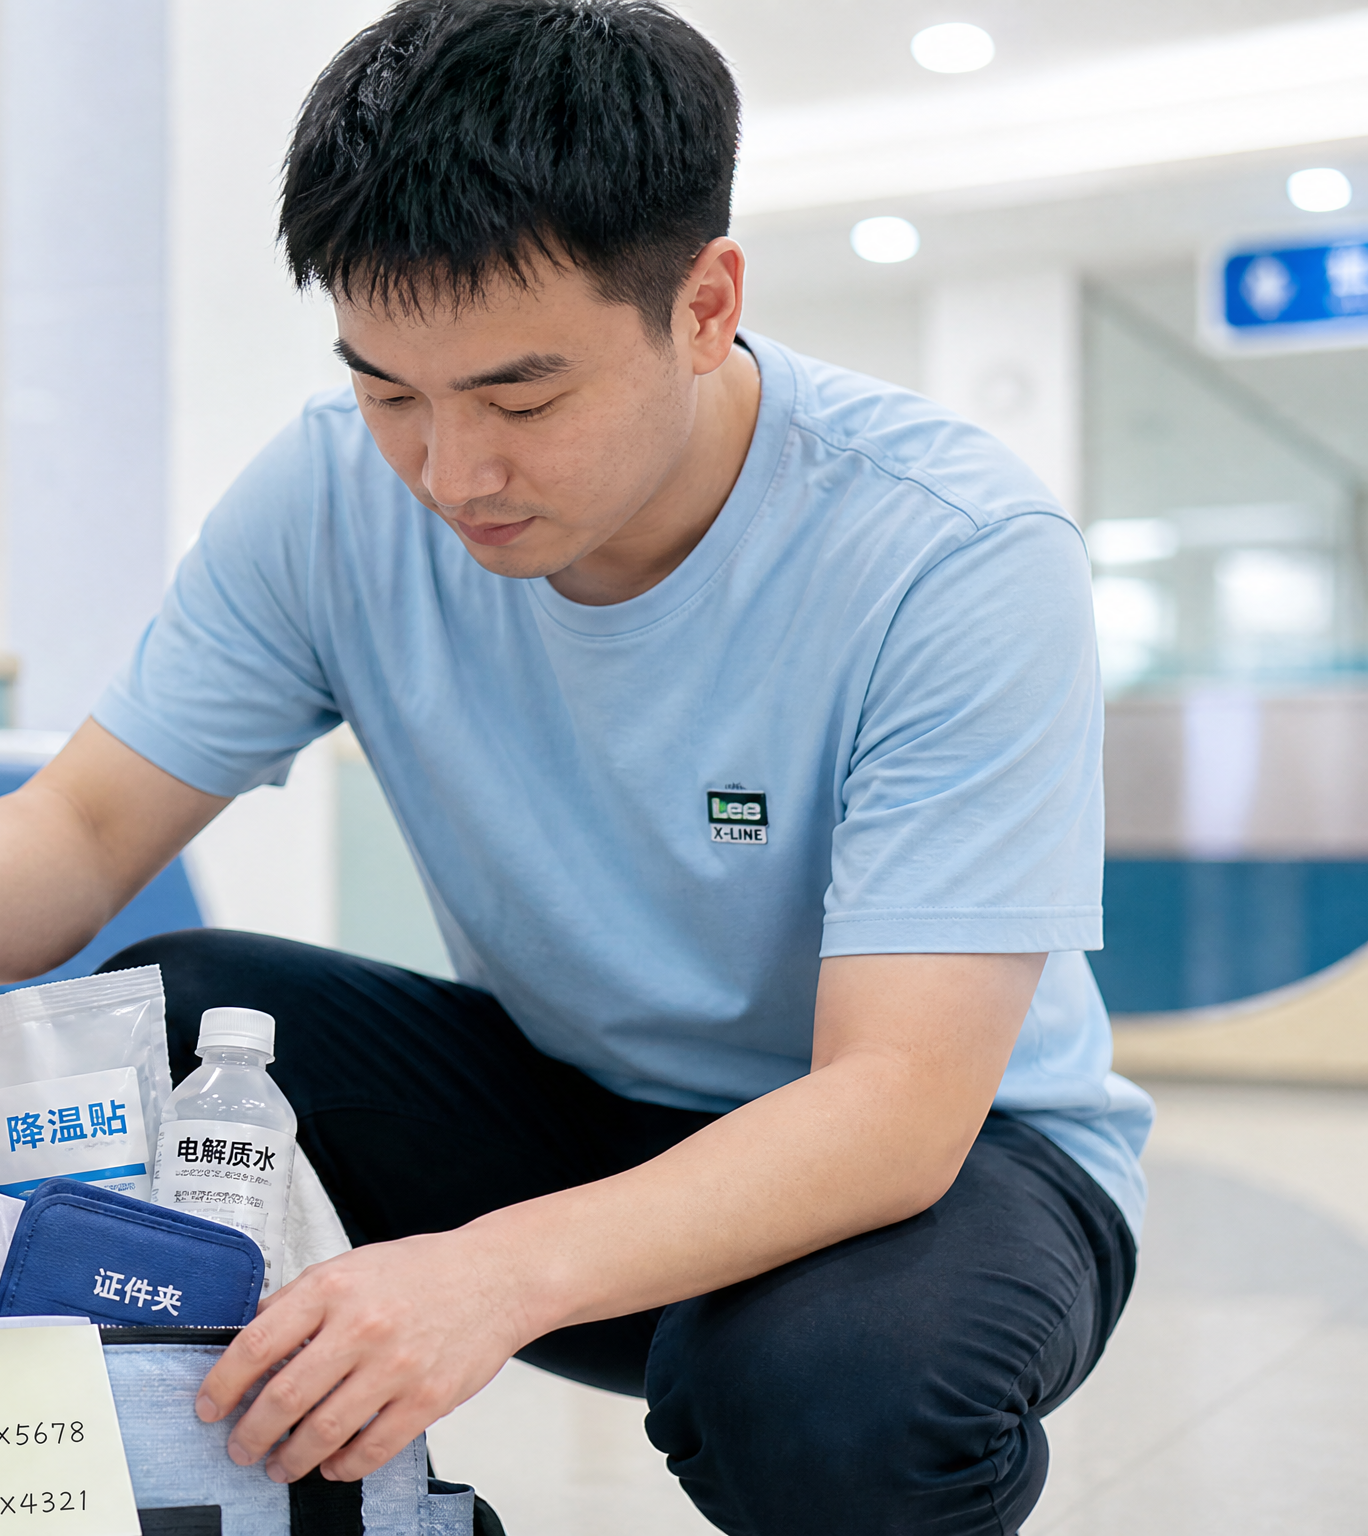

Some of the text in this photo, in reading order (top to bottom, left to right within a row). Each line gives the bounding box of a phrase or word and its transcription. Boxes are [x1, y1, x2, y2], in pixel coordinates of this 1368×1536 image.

[711, 797, 761, 820] Lee
[713, 826, 763, 841] X-LINE
[6, 1099, 128, 1152] 降温贴
[177, 1136, 276, 1171] 电解质水
[93, 1268, 183, 1317] 证件夹
